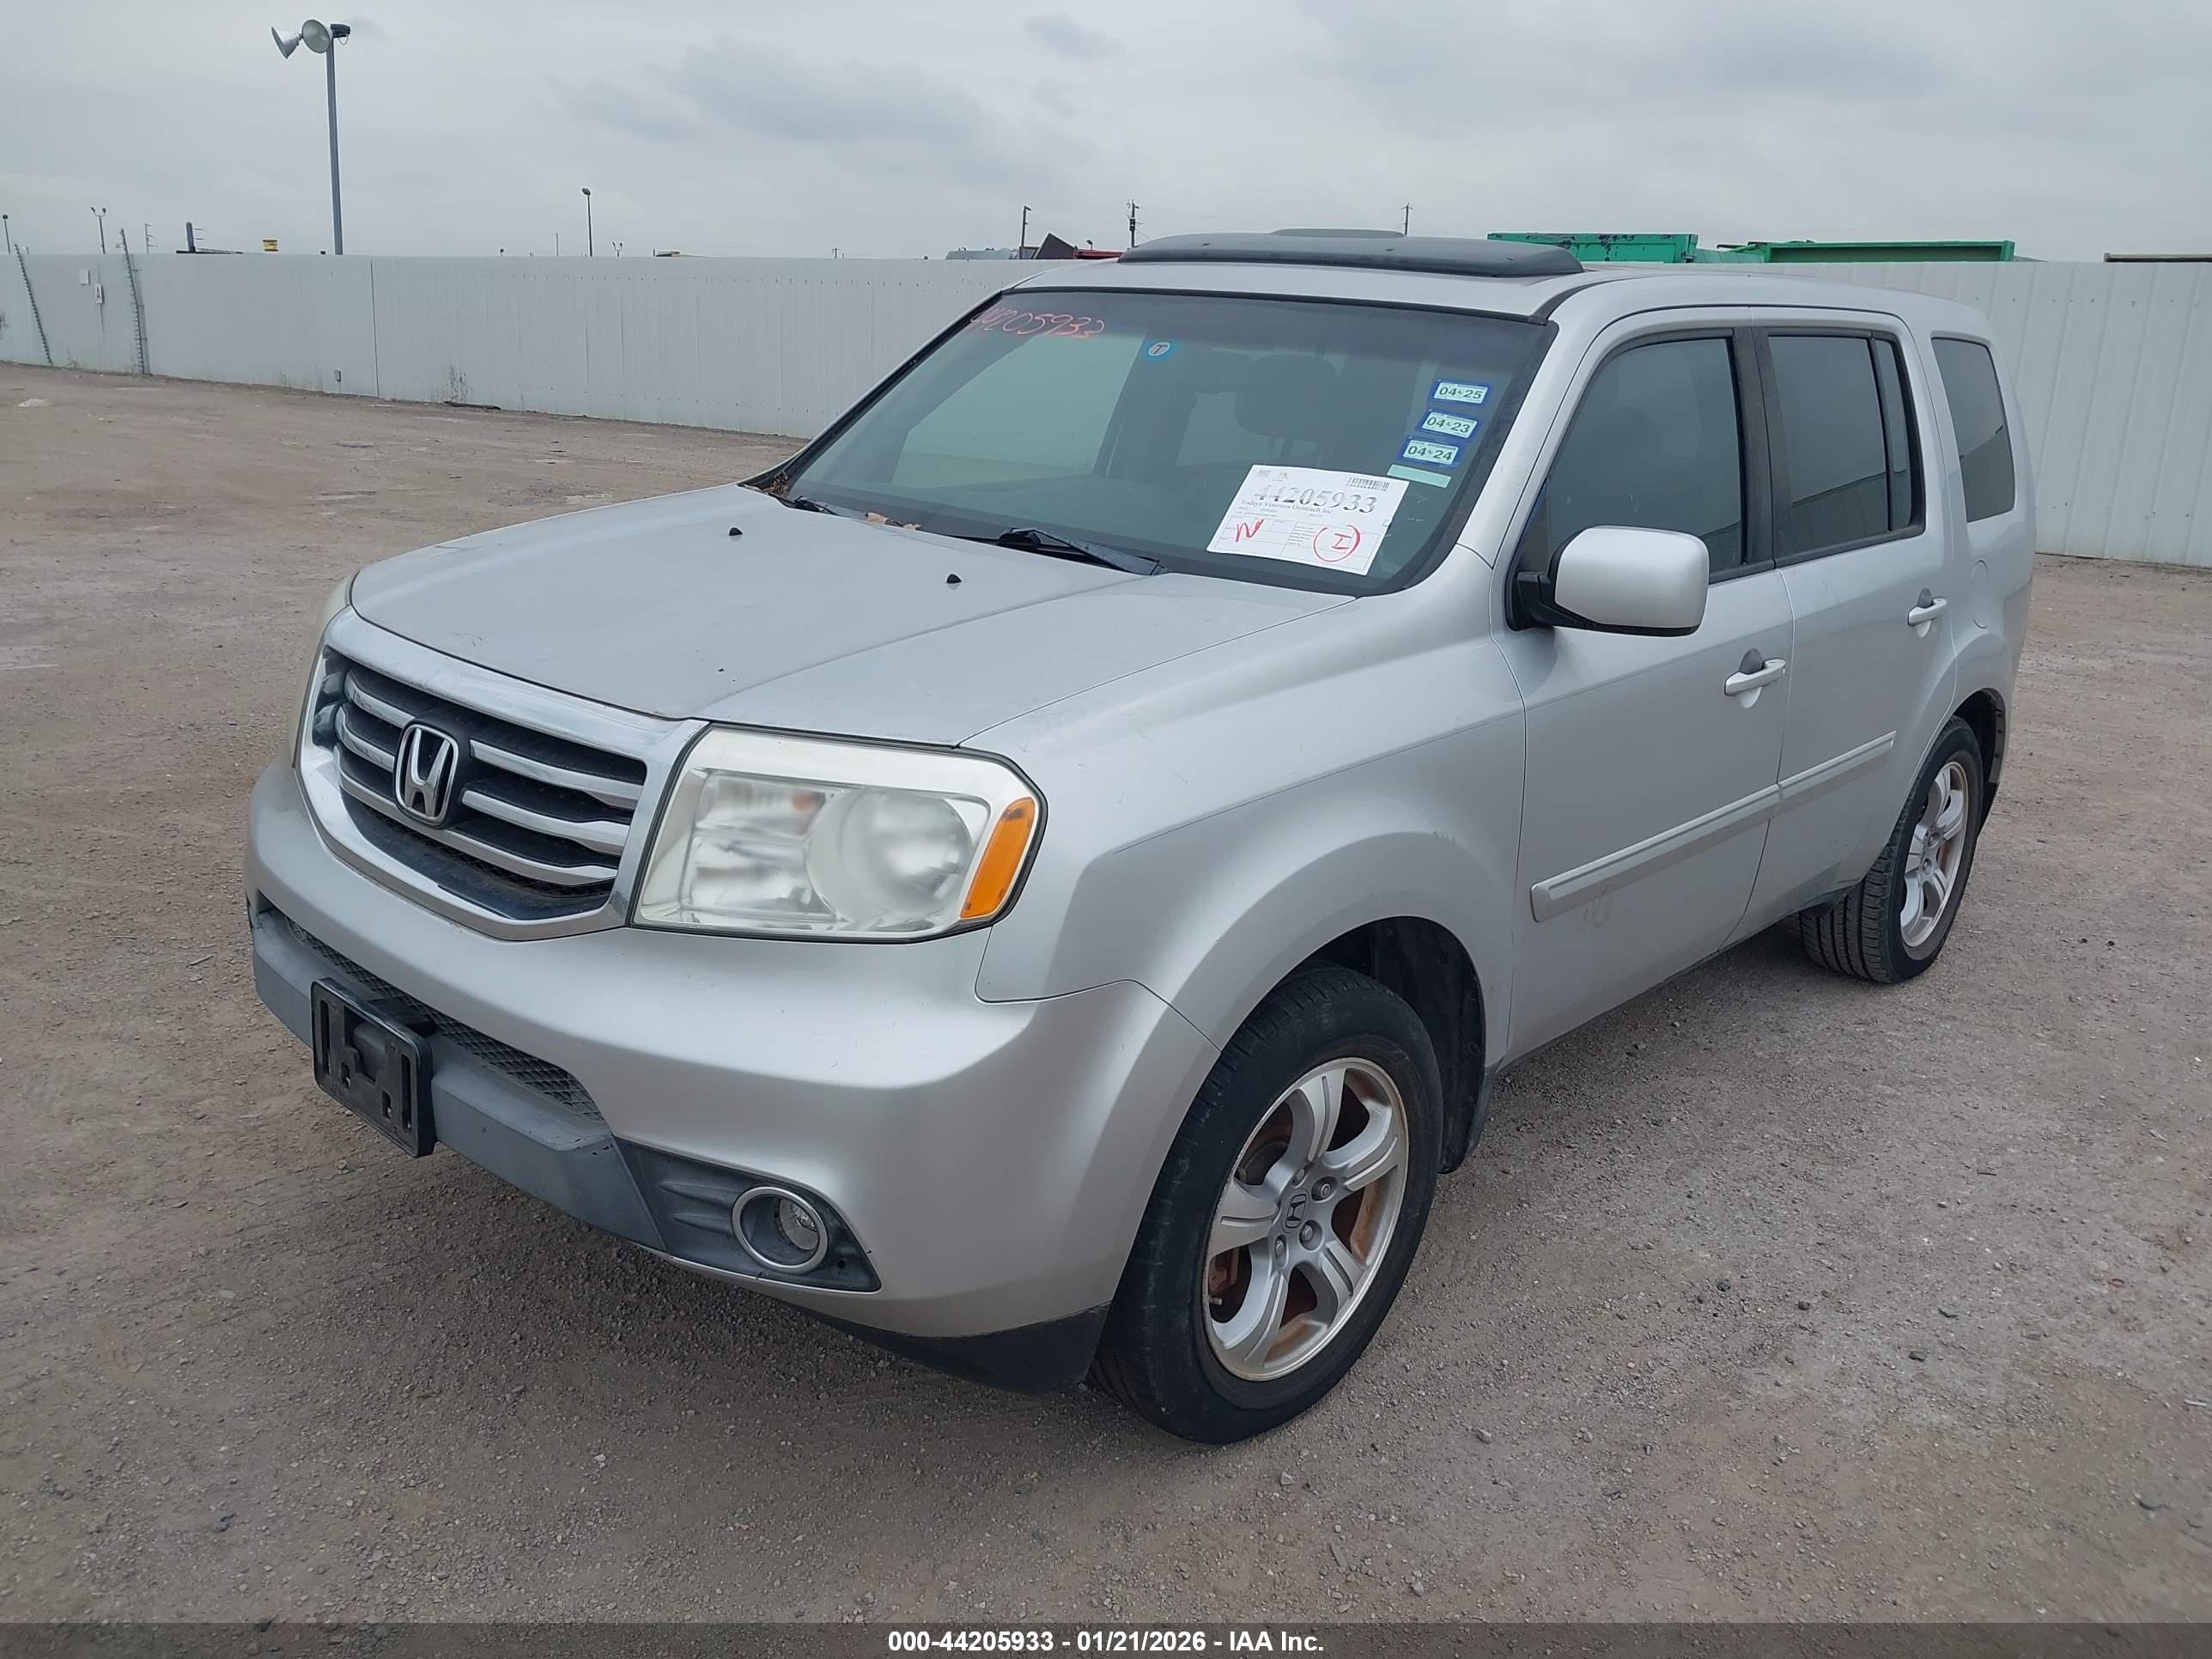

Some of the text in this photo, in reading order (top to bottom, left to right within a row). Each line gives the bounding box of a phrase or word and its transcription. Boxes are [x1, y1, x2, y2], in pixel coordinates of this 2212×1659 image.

[1463, 389, 1483, 399] 25
[1450, 422, 1470, 434] 23
[1432, 450, 1452, 461] 24
[1254, 483, 1378, 514] 44205933
